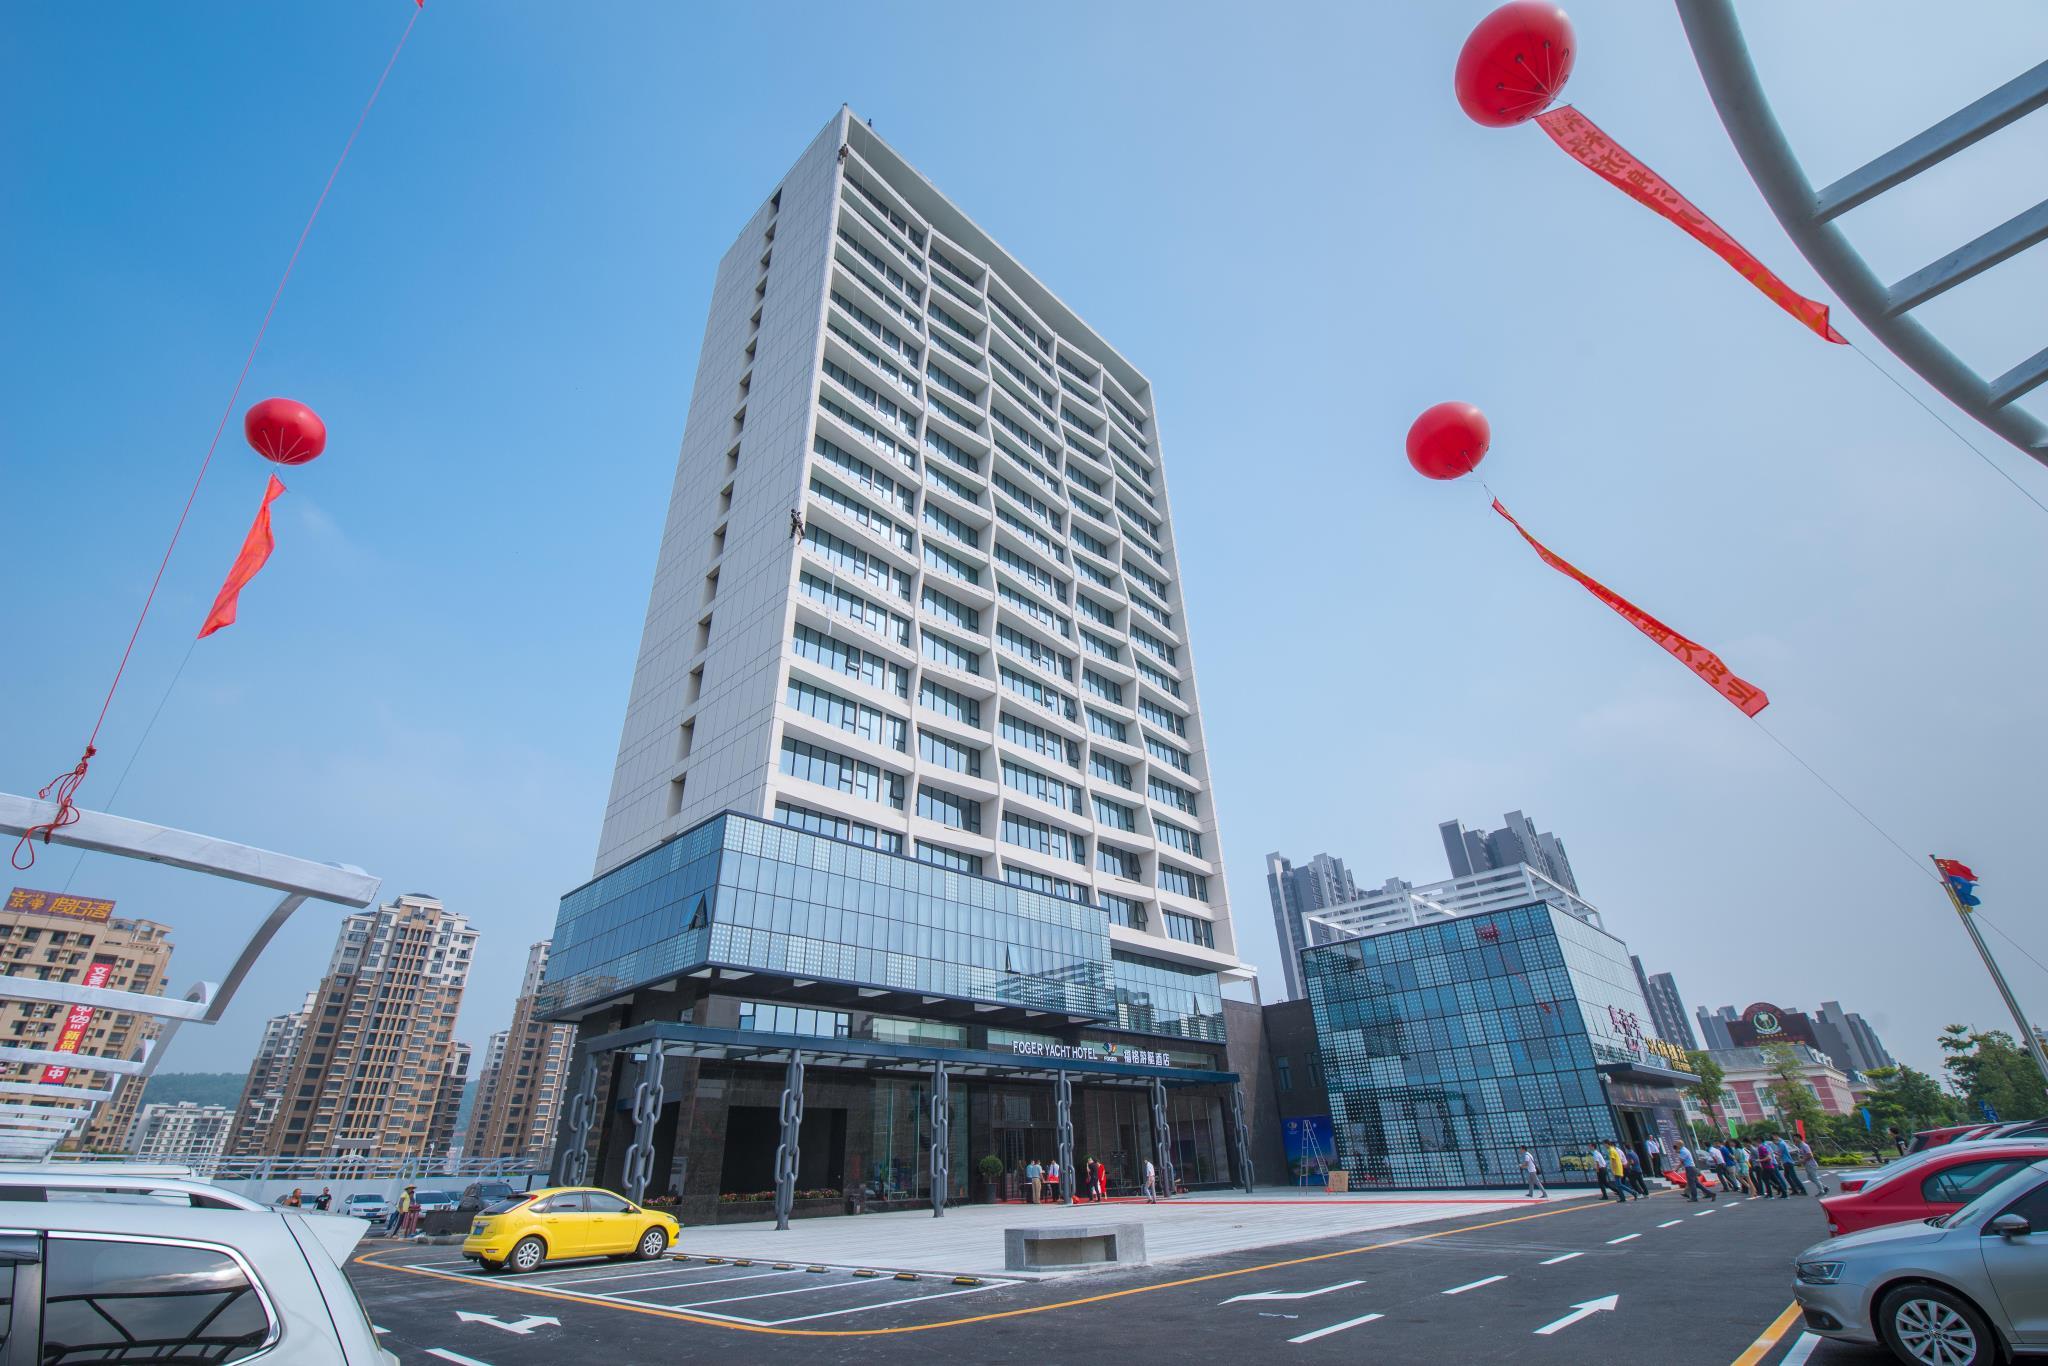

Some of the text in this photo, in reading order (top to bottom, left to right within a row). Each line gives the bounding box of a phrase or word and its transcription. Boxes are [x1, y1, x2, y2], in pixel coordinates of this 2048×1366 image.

[1013, 1041, 1098, 1060] FOGER YACHT HOTEL
[1123, 1049, 1170, 1066] 福格游艇酒店
